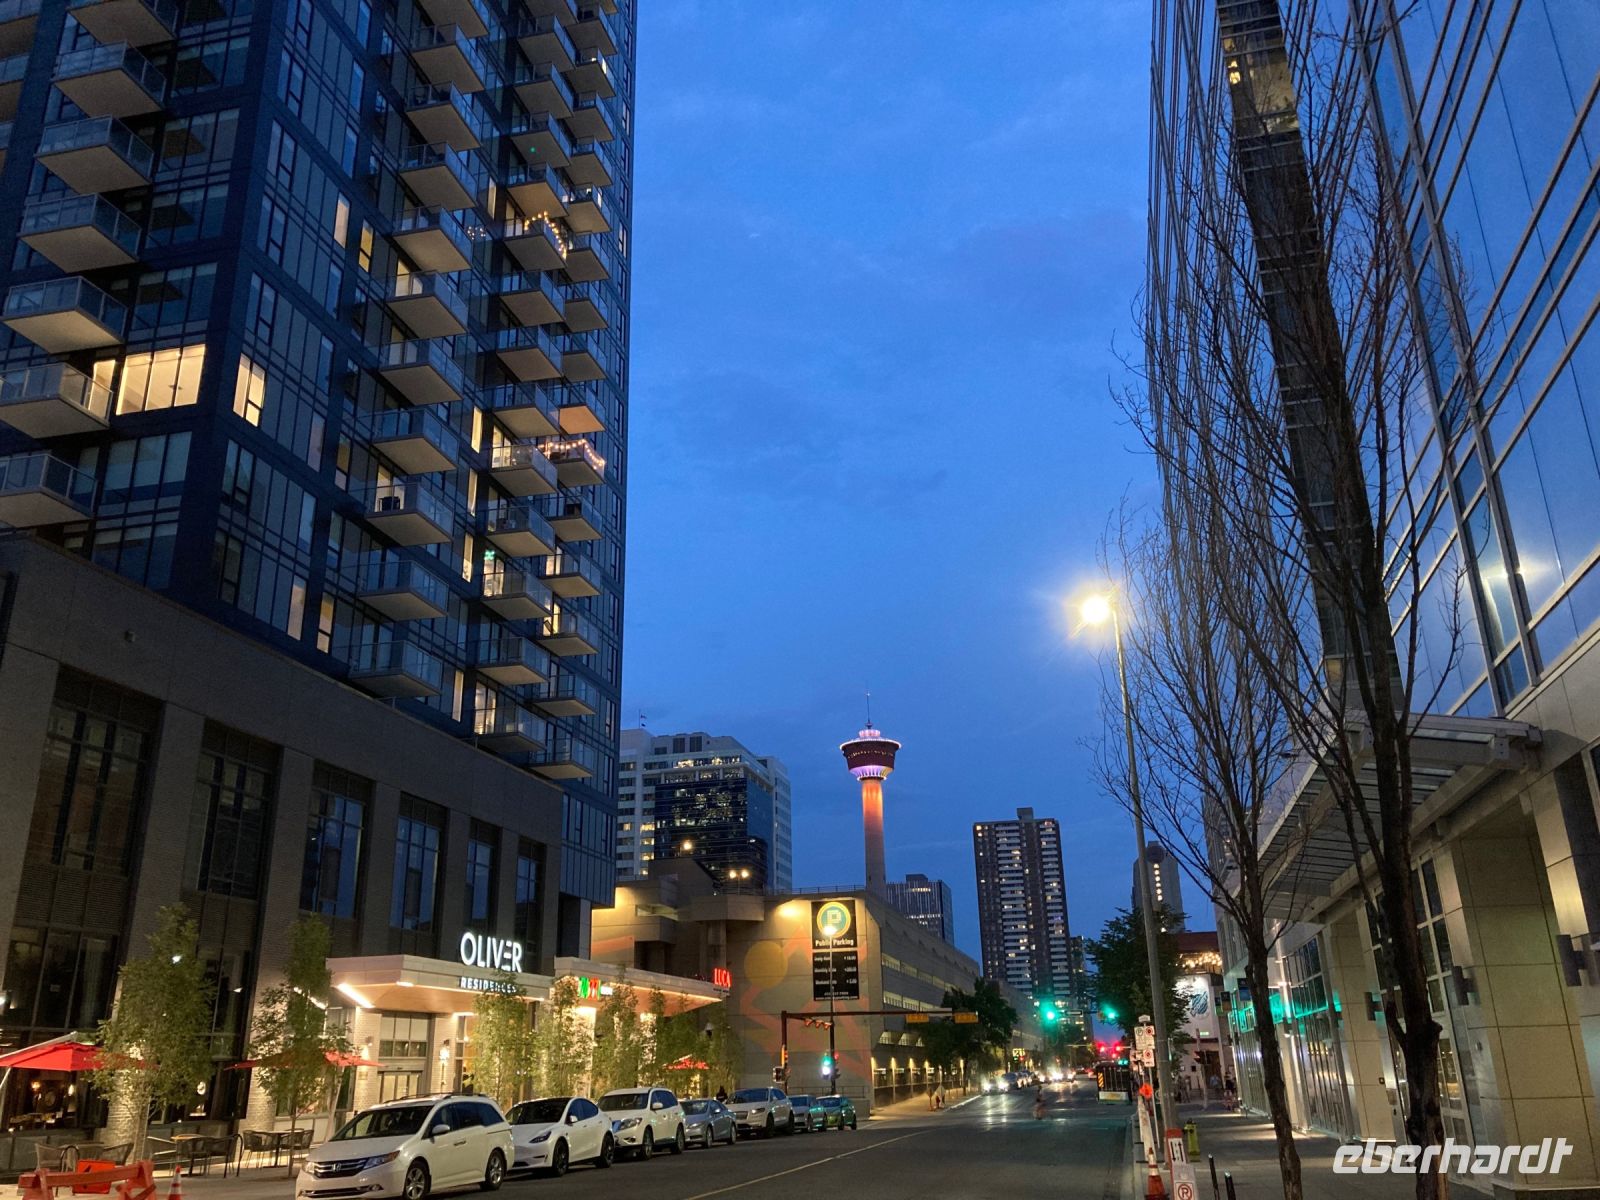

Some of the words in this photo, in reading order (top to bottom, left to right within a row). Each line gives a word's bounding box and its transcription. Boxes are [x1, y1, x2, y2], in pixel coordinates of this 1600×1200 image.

[460, 931, 523, 973] OLIVER
[833, 938, 854, 947] Parking
[713, 967, 732, 988] LUCA
